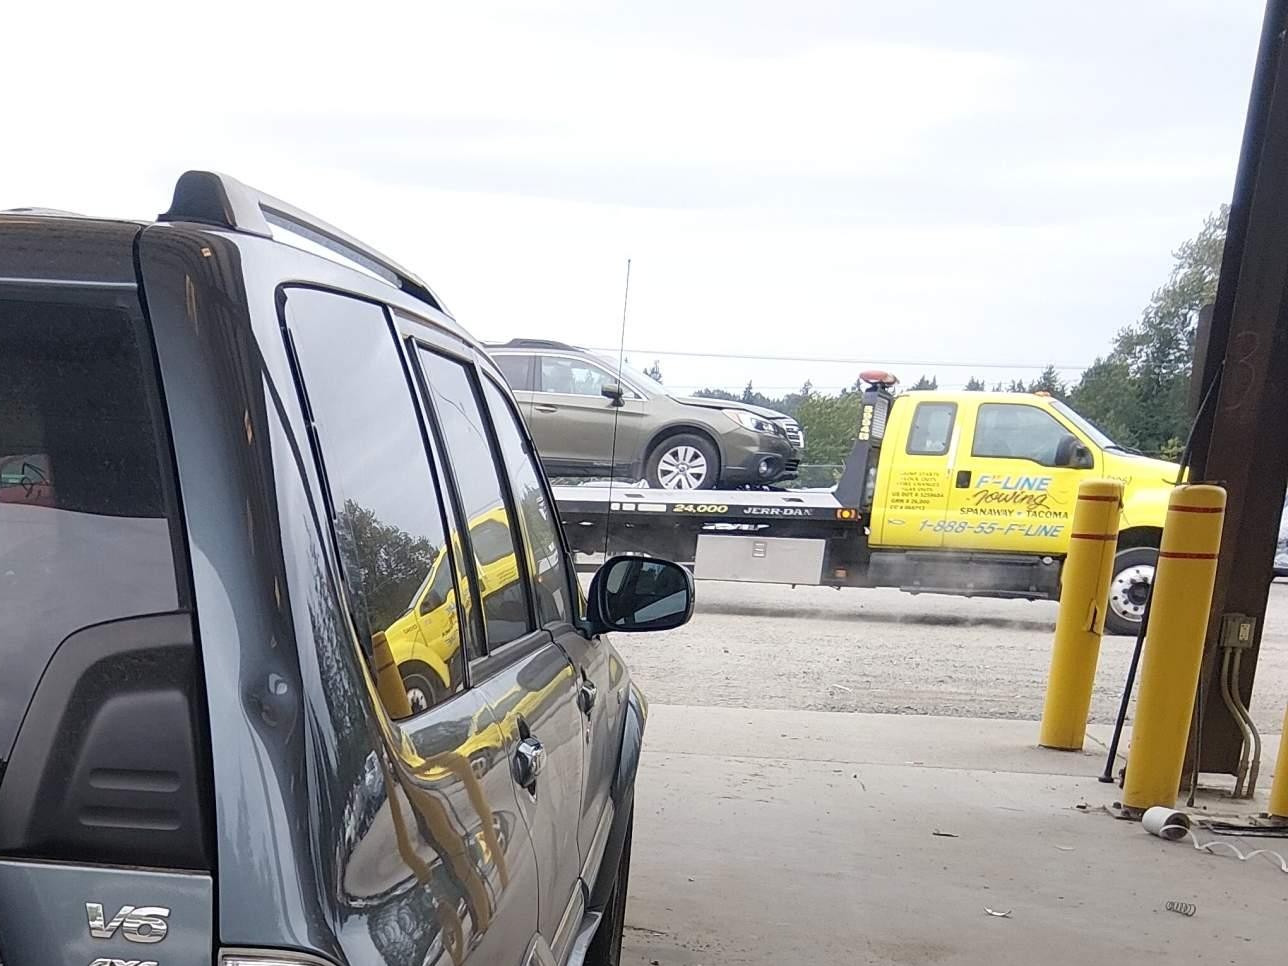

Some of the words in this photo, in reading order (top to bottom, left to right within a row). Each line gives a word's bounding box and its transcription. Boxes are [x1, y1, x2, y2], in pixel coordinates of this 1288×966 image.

[973, 489, 1050, 510] Towing
[672, 504, 729, 514] 24,000
[959, 507, 1015, 518] SPANAWAY
[1026, 509, 1069, 519] TACOMA
[85, 902, 171, 943] V6
